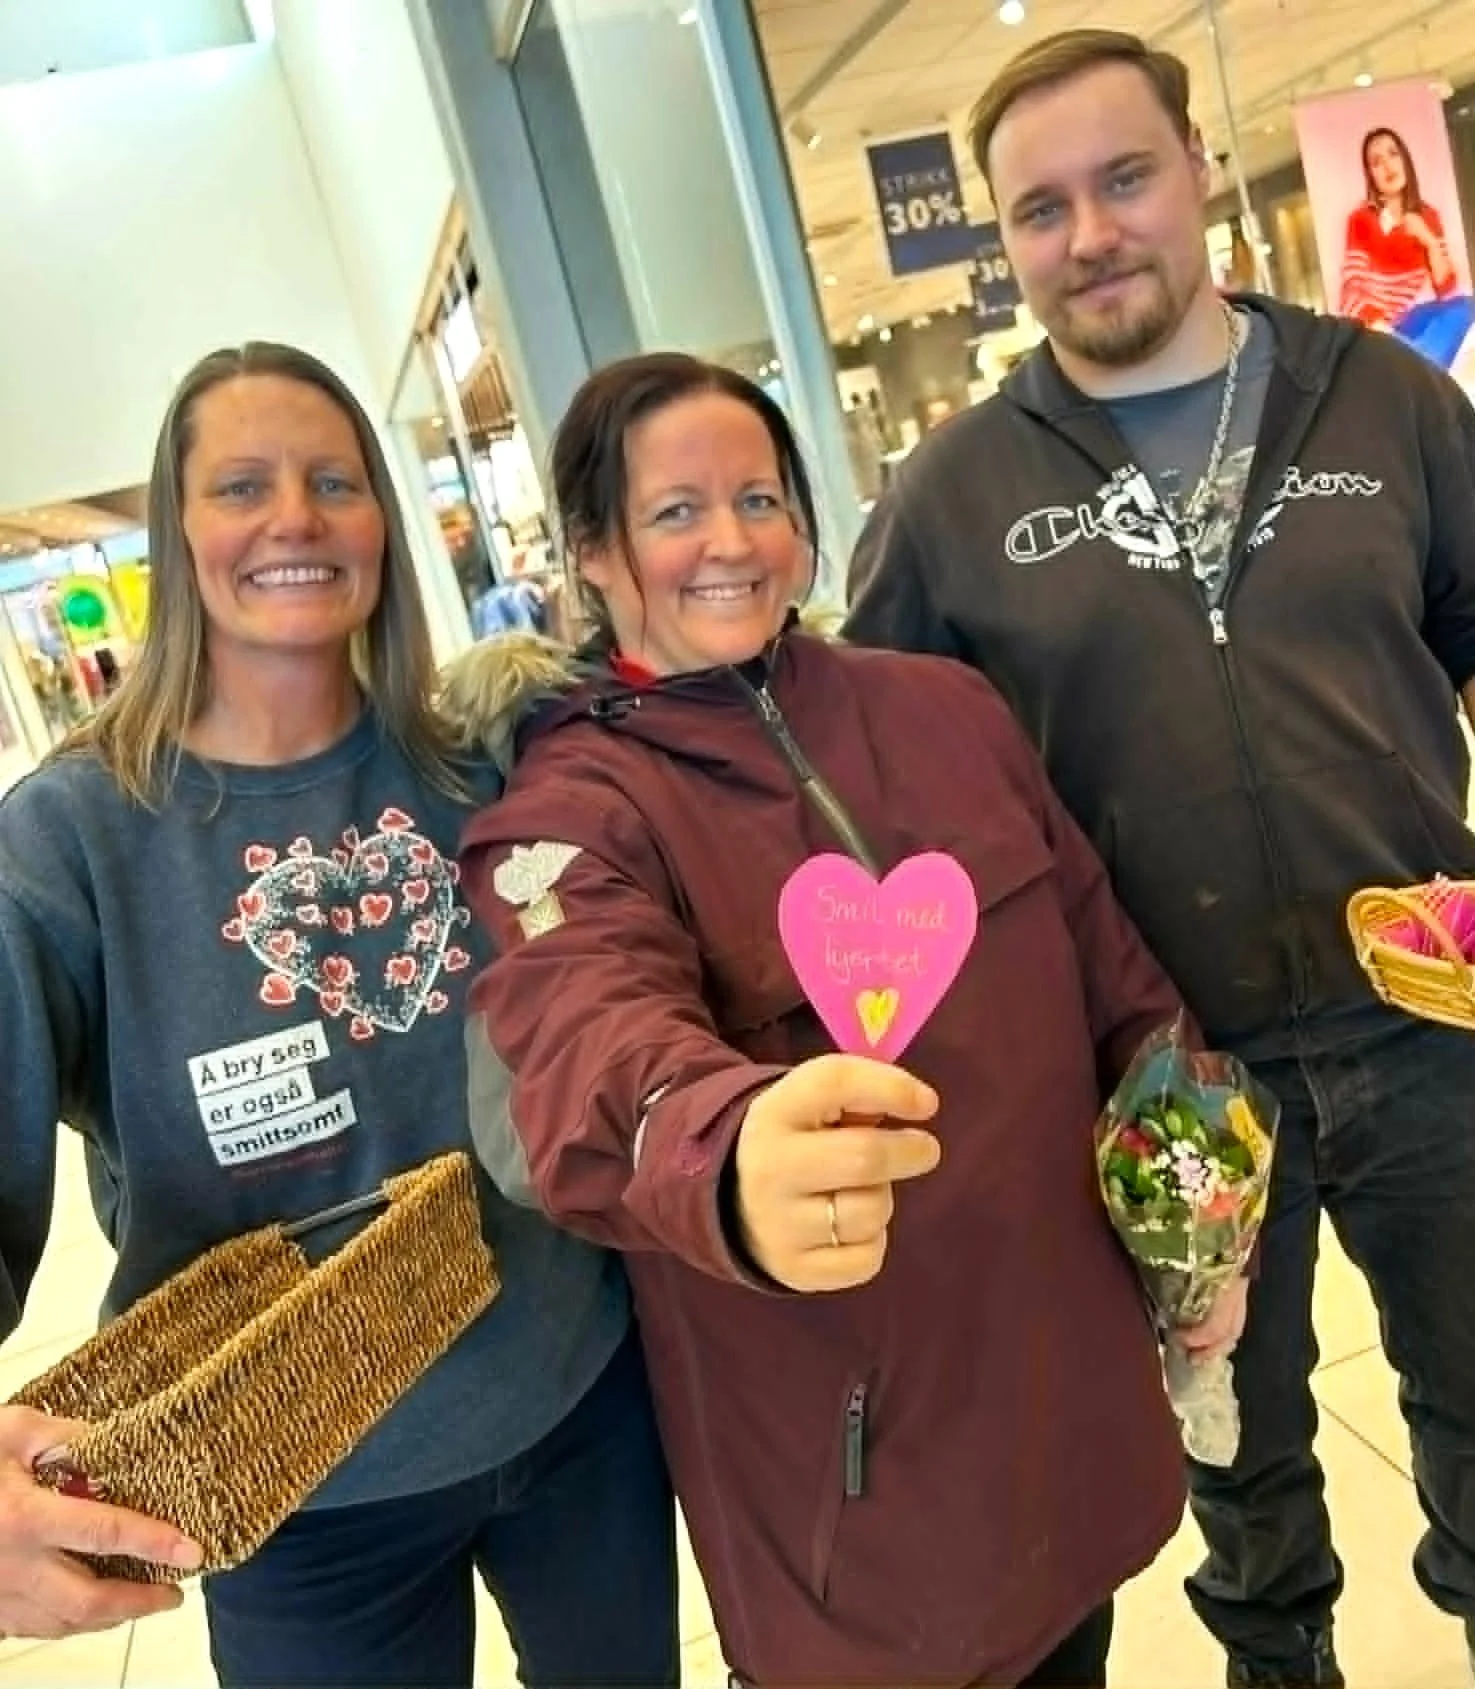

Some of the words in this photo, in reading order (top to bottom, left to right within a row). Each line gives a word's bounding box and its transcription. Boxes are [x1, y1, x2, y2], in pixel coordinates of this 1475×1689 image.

[885, 191, 962, 236] 30%
[896, 901, 948, 930] med
[223, 1054, 265, 1080] bry
[271, 1039, 318, 1065] seg
[210, 1104, 234, 1125] er
[243, 1077, 303, 1114] også
[220, 1103, 343, 1159] smittsomt
